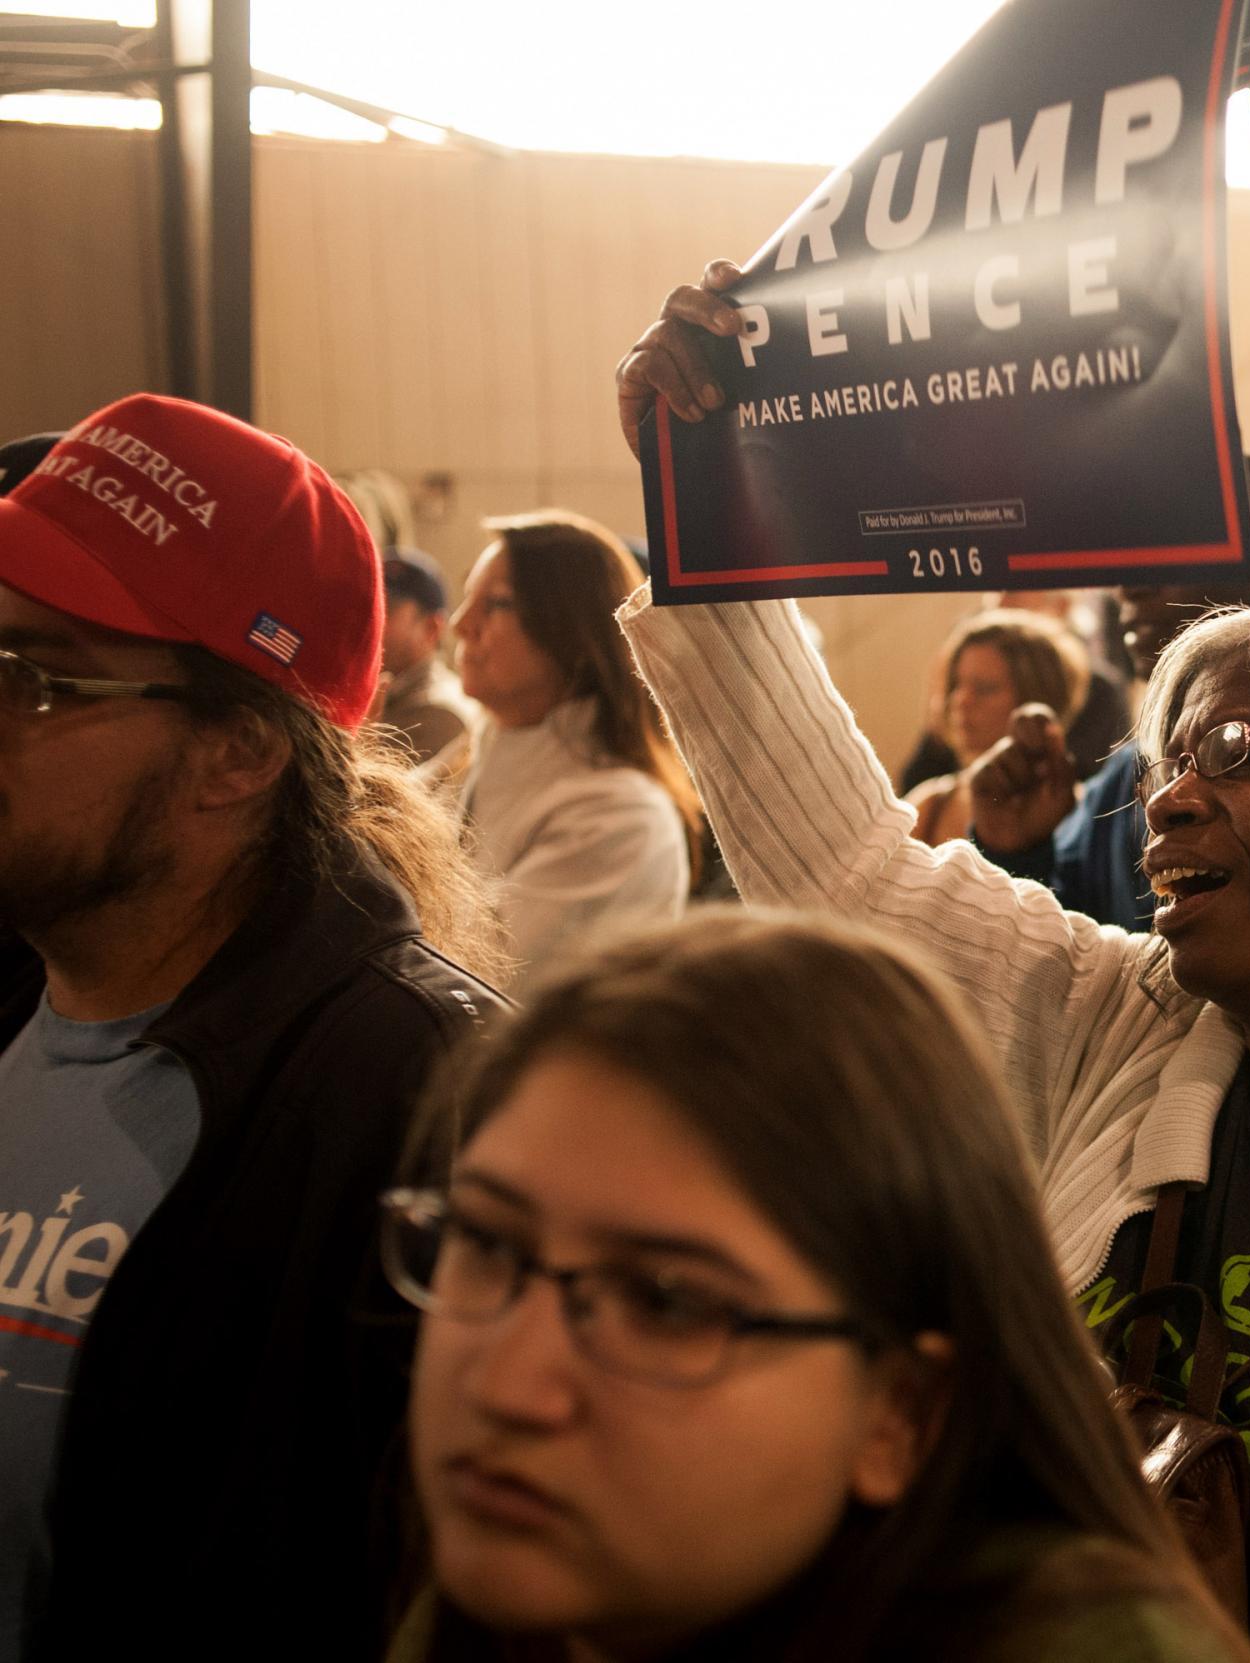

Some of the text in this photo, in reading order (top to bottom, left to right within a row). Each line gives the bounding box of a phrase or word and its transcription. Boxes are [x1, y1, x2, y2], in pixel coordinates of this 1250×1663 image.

[775, 75, 1182, 271] RUMP
[737, 235, 1119, 367] PENCE
[738, 346, 1141, 428] MAKE AMERICA GREAT AGAIN!
[66, 465, 179, 546] AGAIN
[81, 425, 218, 529] AMERICA
[865, 514, 880, 528] Paid
[880, 515, 889, 527] for
[890, 515, 899, 529] by
[901, 513, 923, 526] Donald
[931, 511, 953, 526] Trump
[954, 510, 964, 522] for
[908, 546, 983, 577] 2016
[0, 1186, 129, 1317] nie
